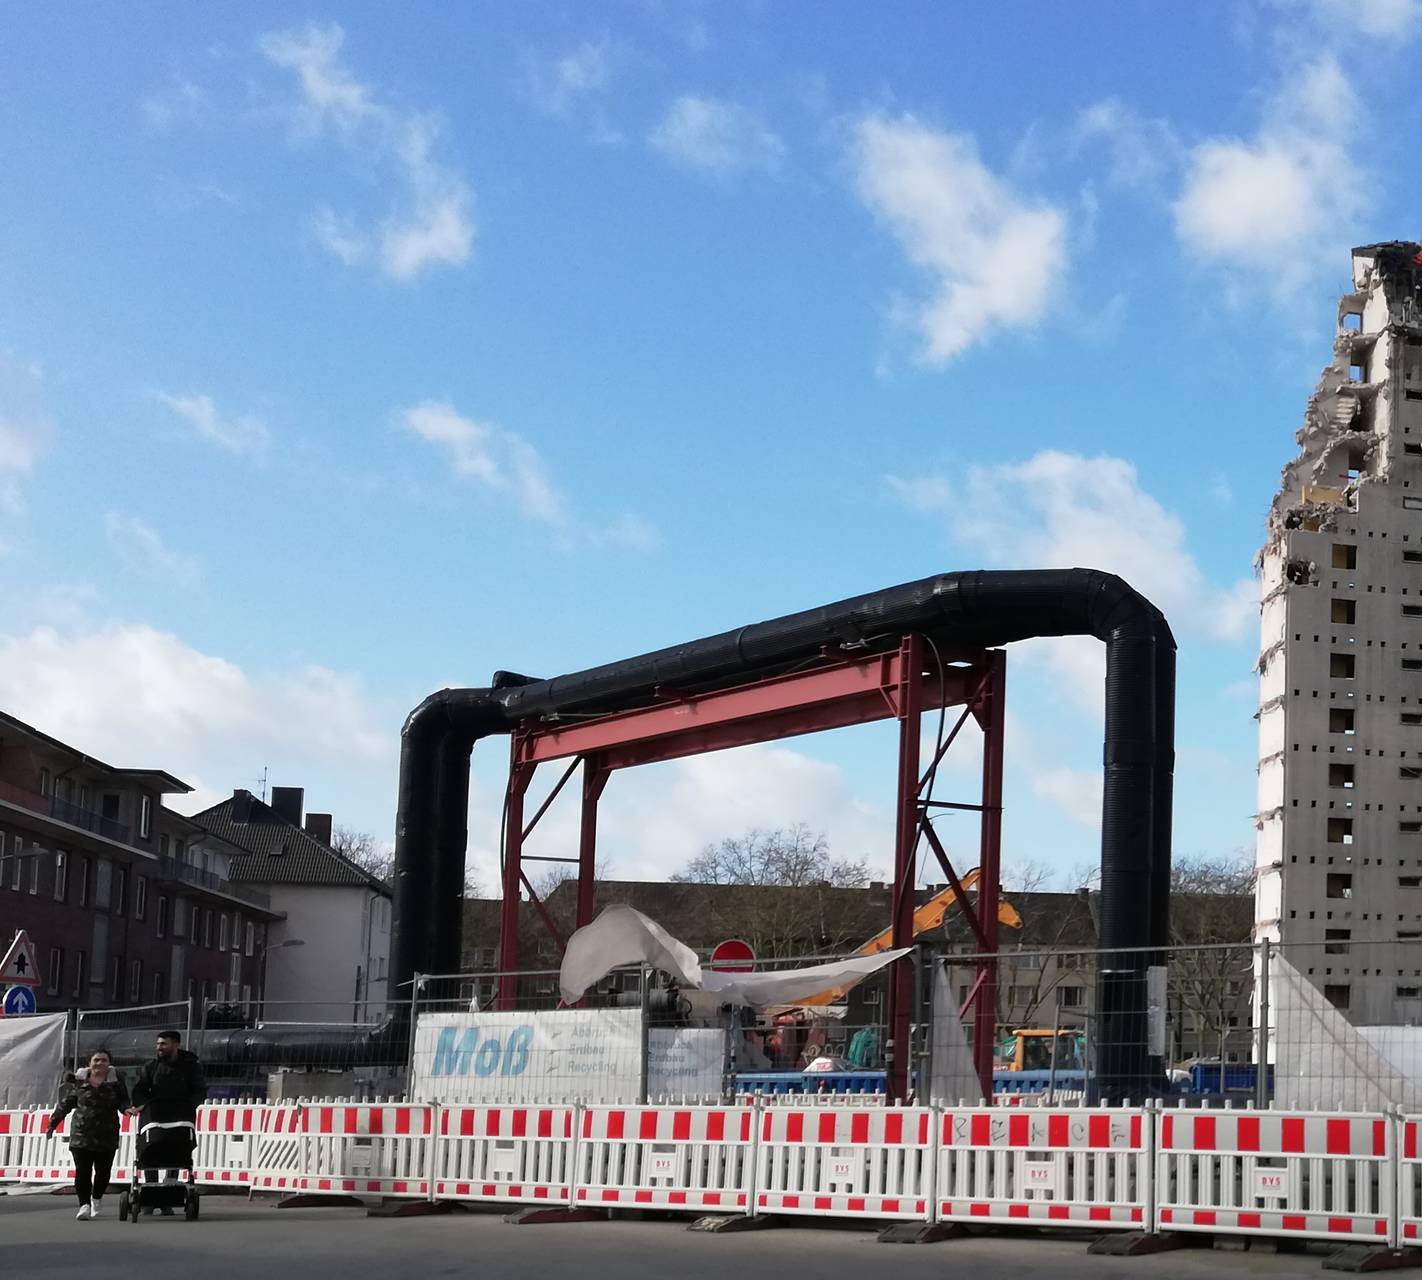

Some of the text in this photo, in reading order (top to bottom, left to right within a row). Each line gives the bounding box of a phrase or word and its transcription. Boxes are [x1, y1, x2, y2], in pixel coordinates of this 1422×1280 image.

[431, 1025, 534, 1077] Moß
[568, 1060, 617, 1076] Recycling
[1262, 1176, 1281, 1185] BVS
